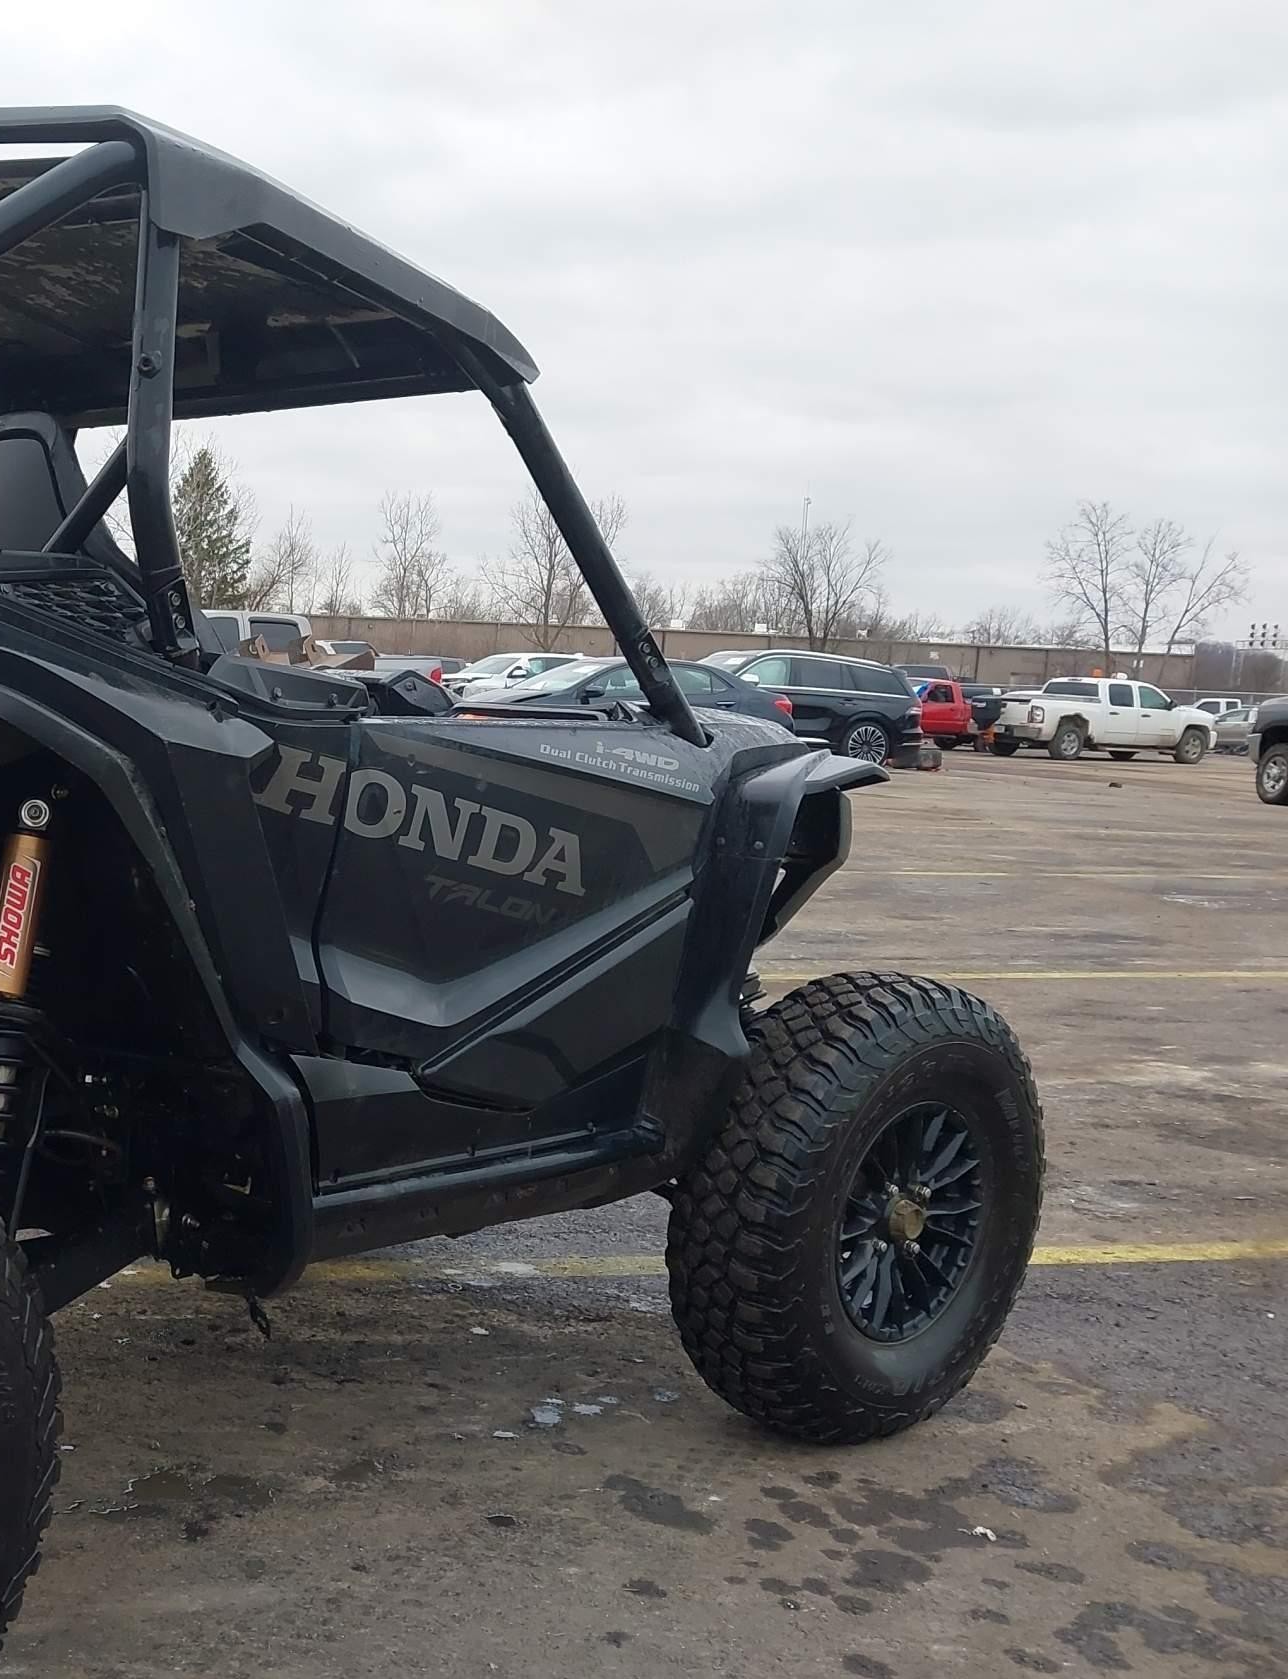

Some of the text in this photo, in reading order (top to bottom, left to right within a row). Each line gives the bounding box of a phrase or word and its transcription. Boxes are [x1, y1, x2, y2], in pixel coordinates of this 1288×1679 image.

[539, 743, 701, 794] Dual Clutch Transmission
[595, 741, 680, 771] i-4WD
[252, 742, 585, 897] HONDA
[424, 873, 559, 925] TALON
